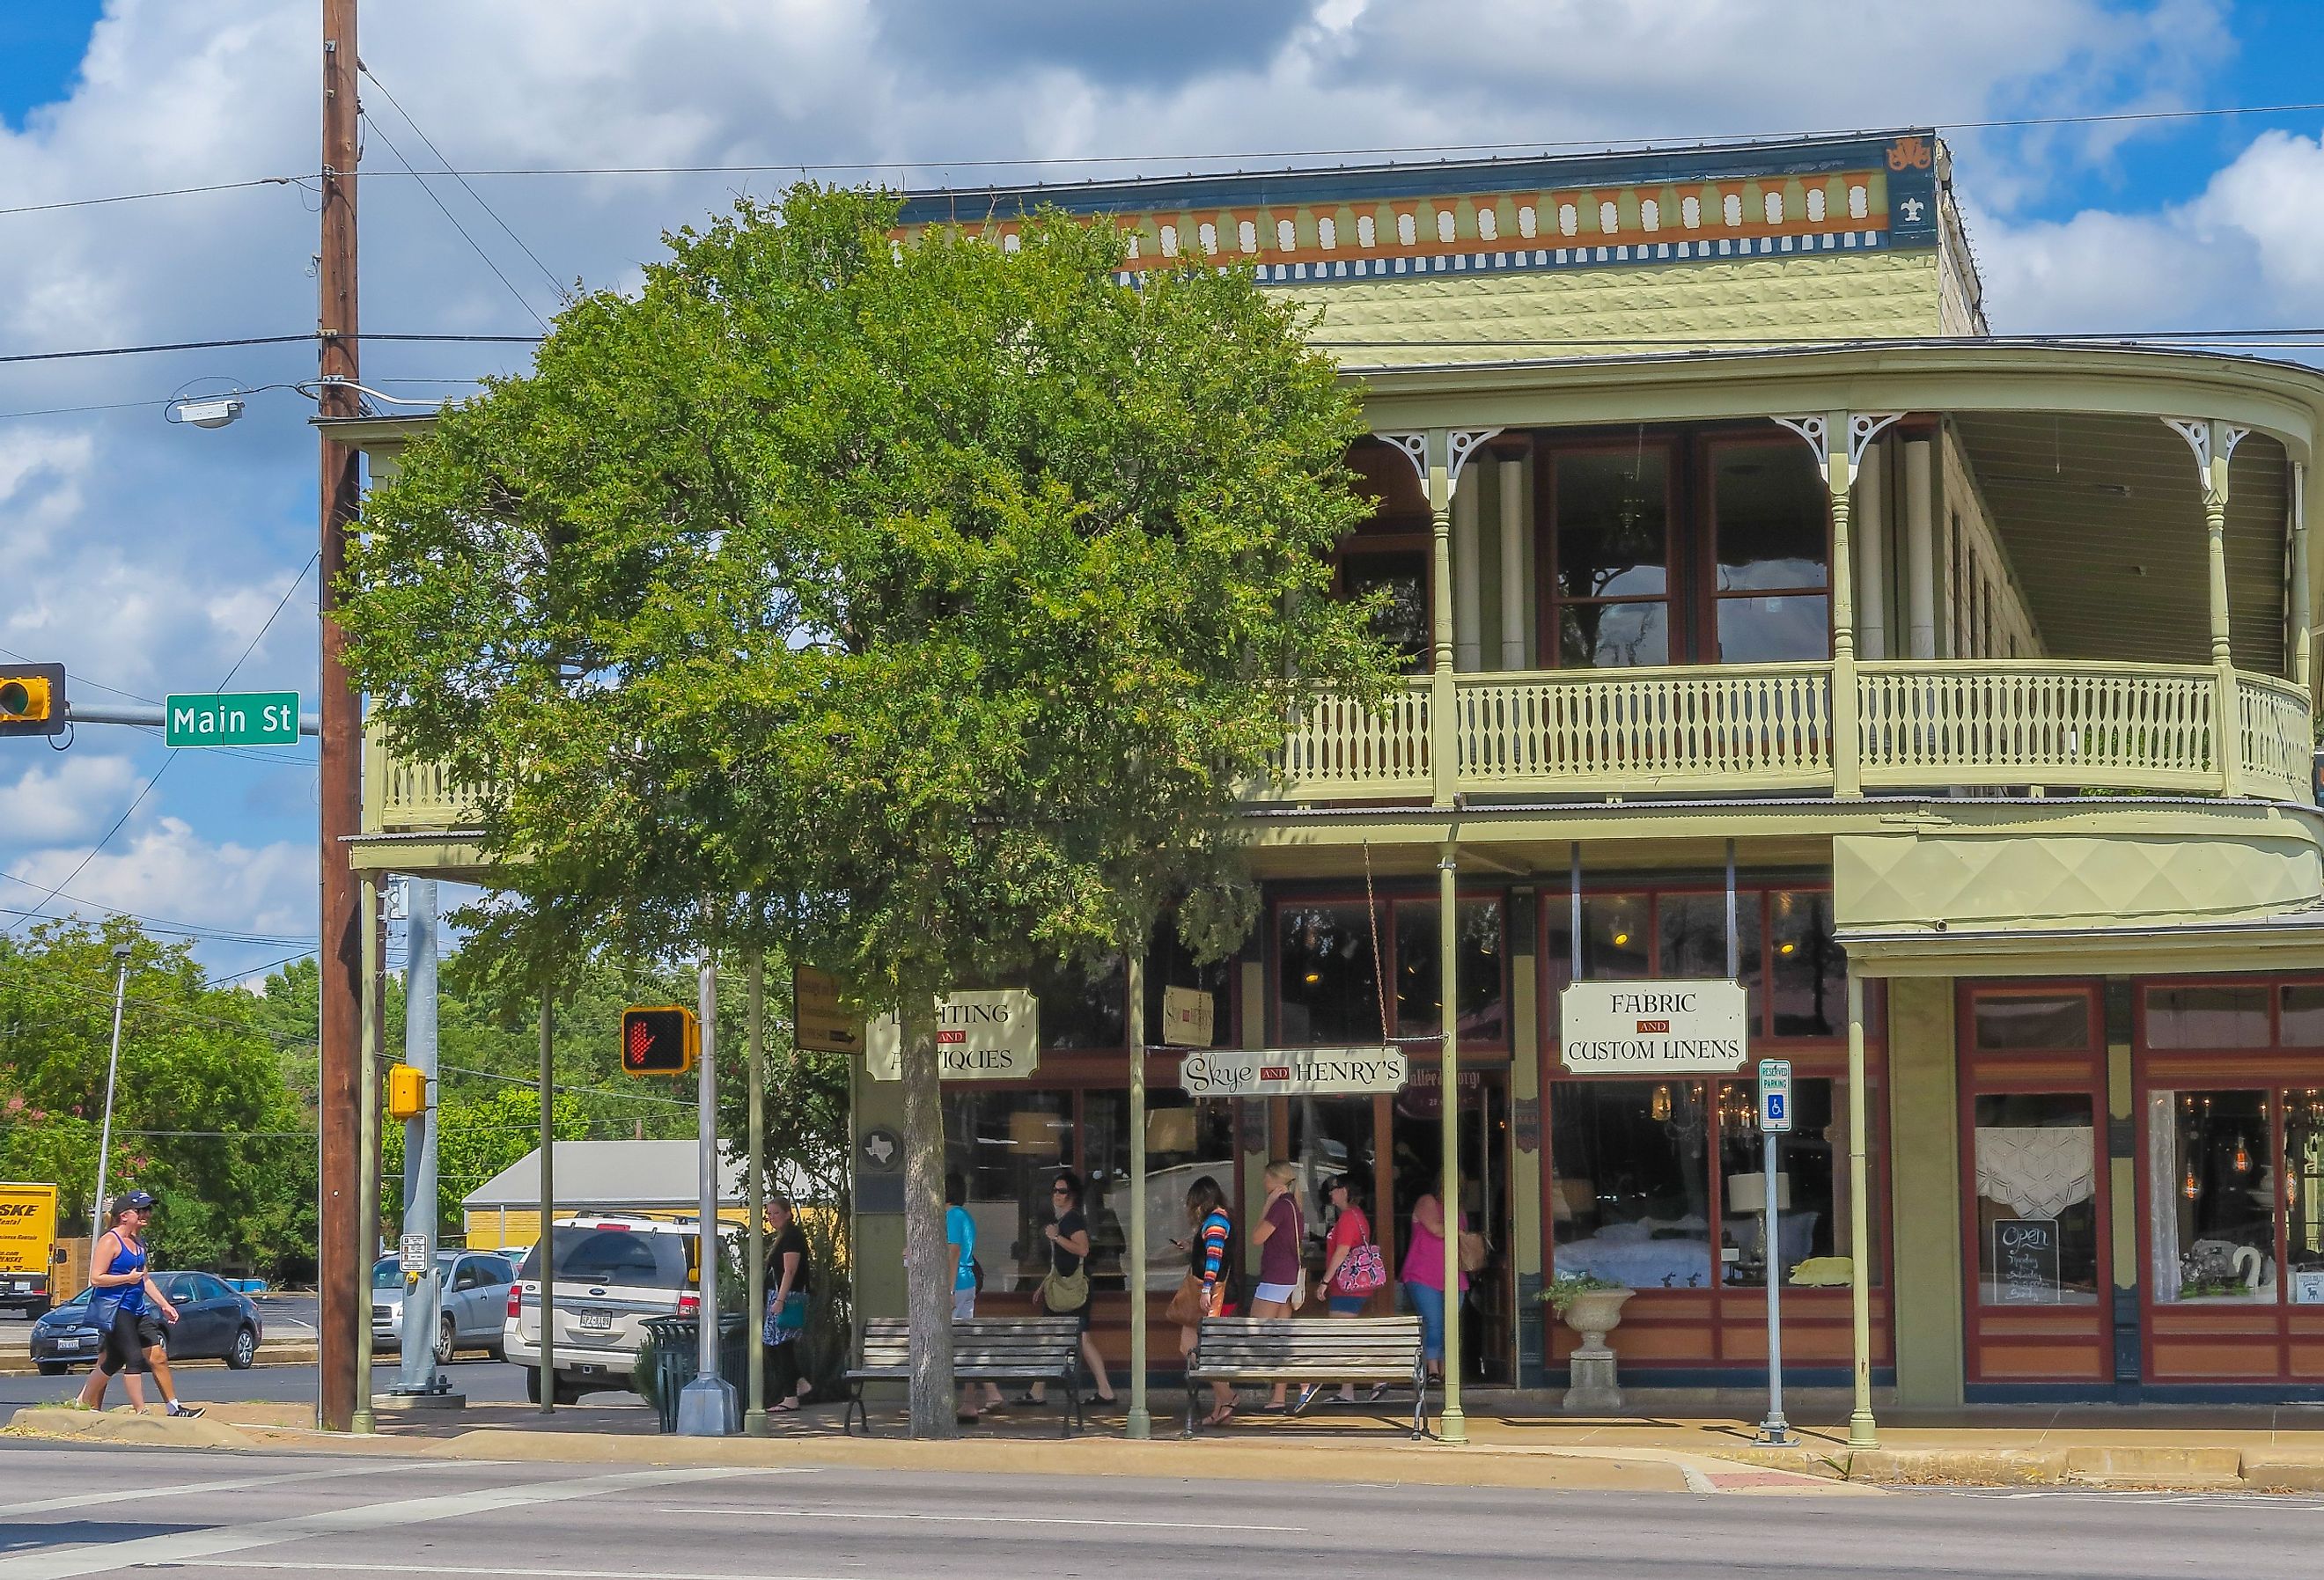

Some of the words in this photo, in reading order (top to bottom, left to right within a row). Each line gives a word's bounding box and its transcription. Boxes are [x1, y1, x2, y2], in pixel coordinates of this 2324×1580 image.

[173, 705, 246, 733] Main
[262, 704, 291, 732] St
[1609, 992, 1697, 1013] FABRIC
[1640, 1021, 1667, 1032] AND
[890, 1048, 1013, 1070] AIQUES
[1568, 1040, 1655, 1061] CUSTOM
[1663, 1039, 1739, 1060] LINENS
[1186, 1054, 1254, 1093] Skye
[1261, 1069, 1289, 1079] AND
[1296, 1059, 1401, 1084] HENRY'S
[1762, 1067, 1788, 1077] RESERVED
[1763, 1079, 1787, 1089] PARKING
[2002, 1226, 2048, 1254] Open
